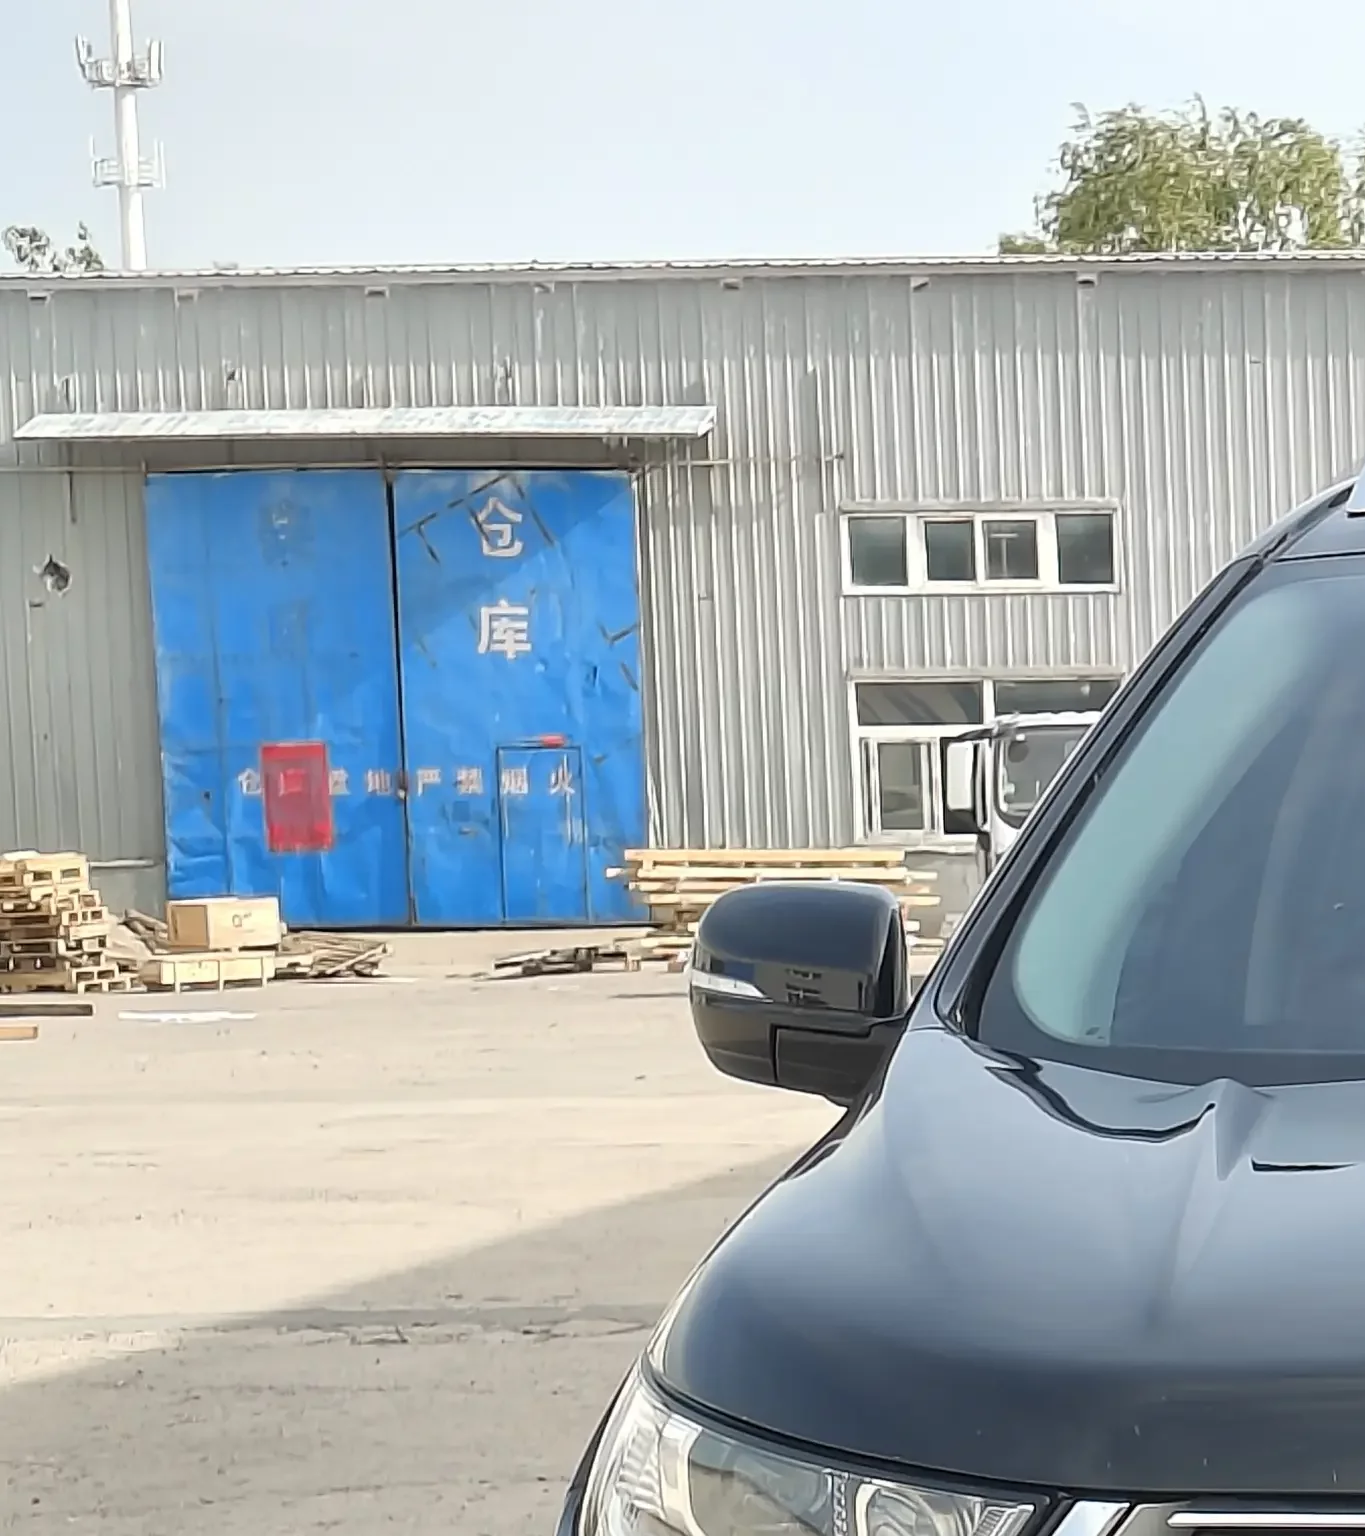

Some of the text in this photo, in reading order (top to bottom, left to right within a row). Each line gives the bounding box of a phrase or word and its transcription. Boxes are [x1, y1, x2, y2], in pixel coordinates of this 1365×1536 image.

[476, 497, 532, 660] 仓库
[237, 764, 575, 796] 仓重地严禁烟火
